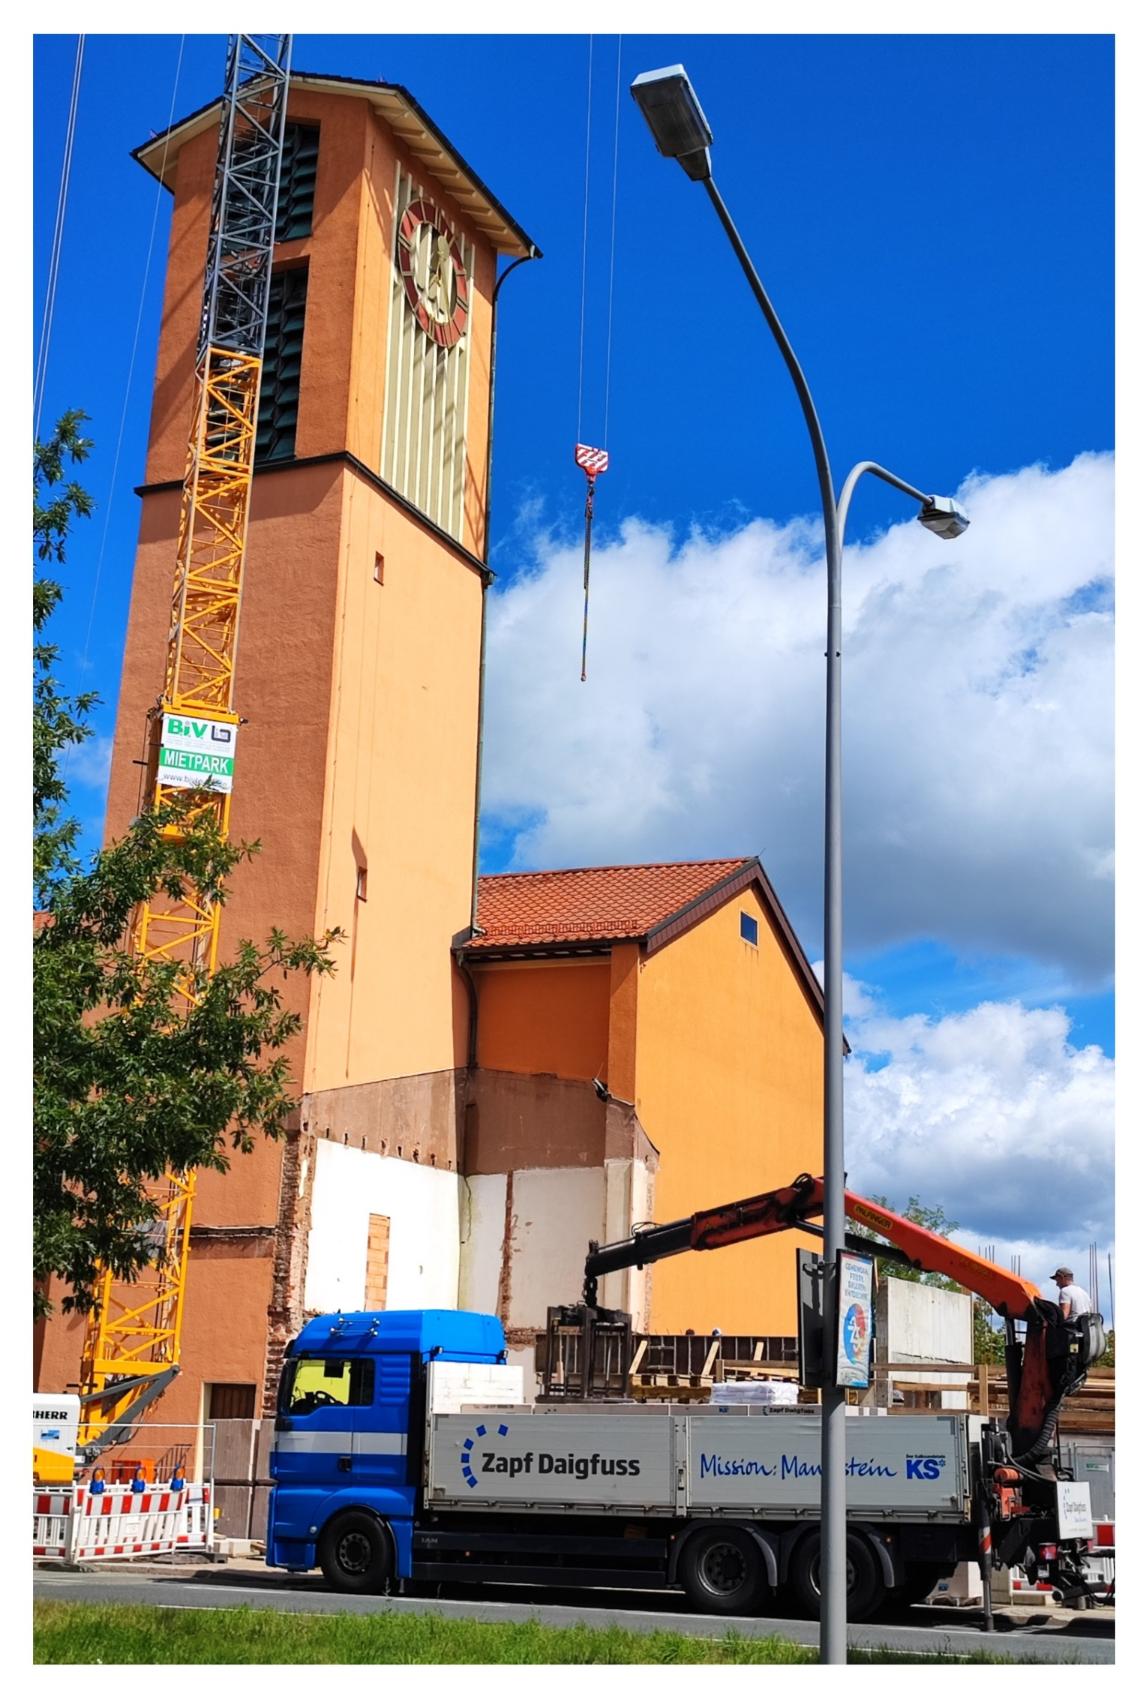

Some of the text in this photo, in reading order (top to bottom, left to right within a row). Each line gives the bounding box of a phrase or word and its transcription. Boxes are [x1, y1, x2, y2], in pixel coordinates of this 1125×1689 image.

[164, 749, 230, 774] MIETPARK
[482, 1452, 640, 1479] Zapf Daigfuss
[700, 1453, 777, 1479] Mission:
